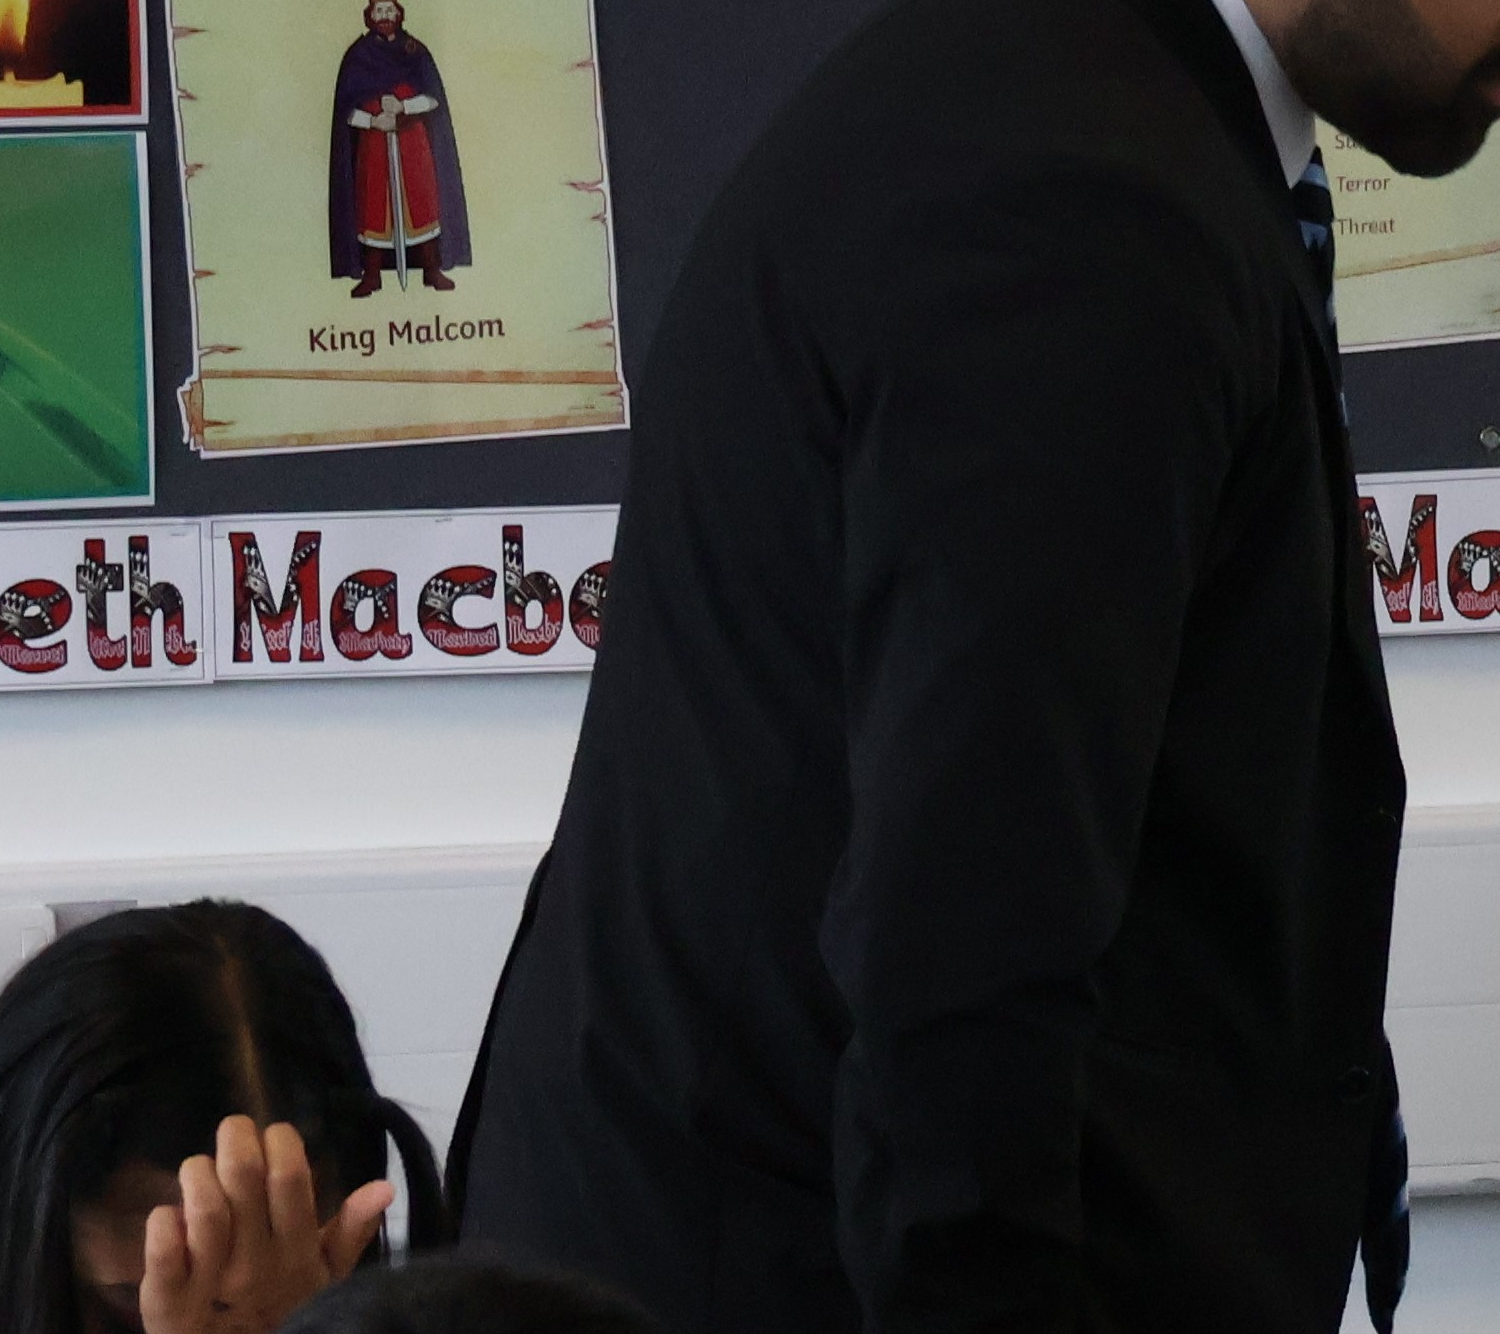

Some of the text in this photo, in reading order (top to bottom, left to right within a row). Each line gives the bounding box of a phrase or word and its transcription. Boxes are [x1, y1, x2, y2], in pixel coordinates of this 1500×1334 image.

[1337, 176, 1391, 192] Terror
[1337, 218, 1396, 235] Threat
[307, 312, 507, 357] King Malcom
[229, 524, 614, 665] Macb
